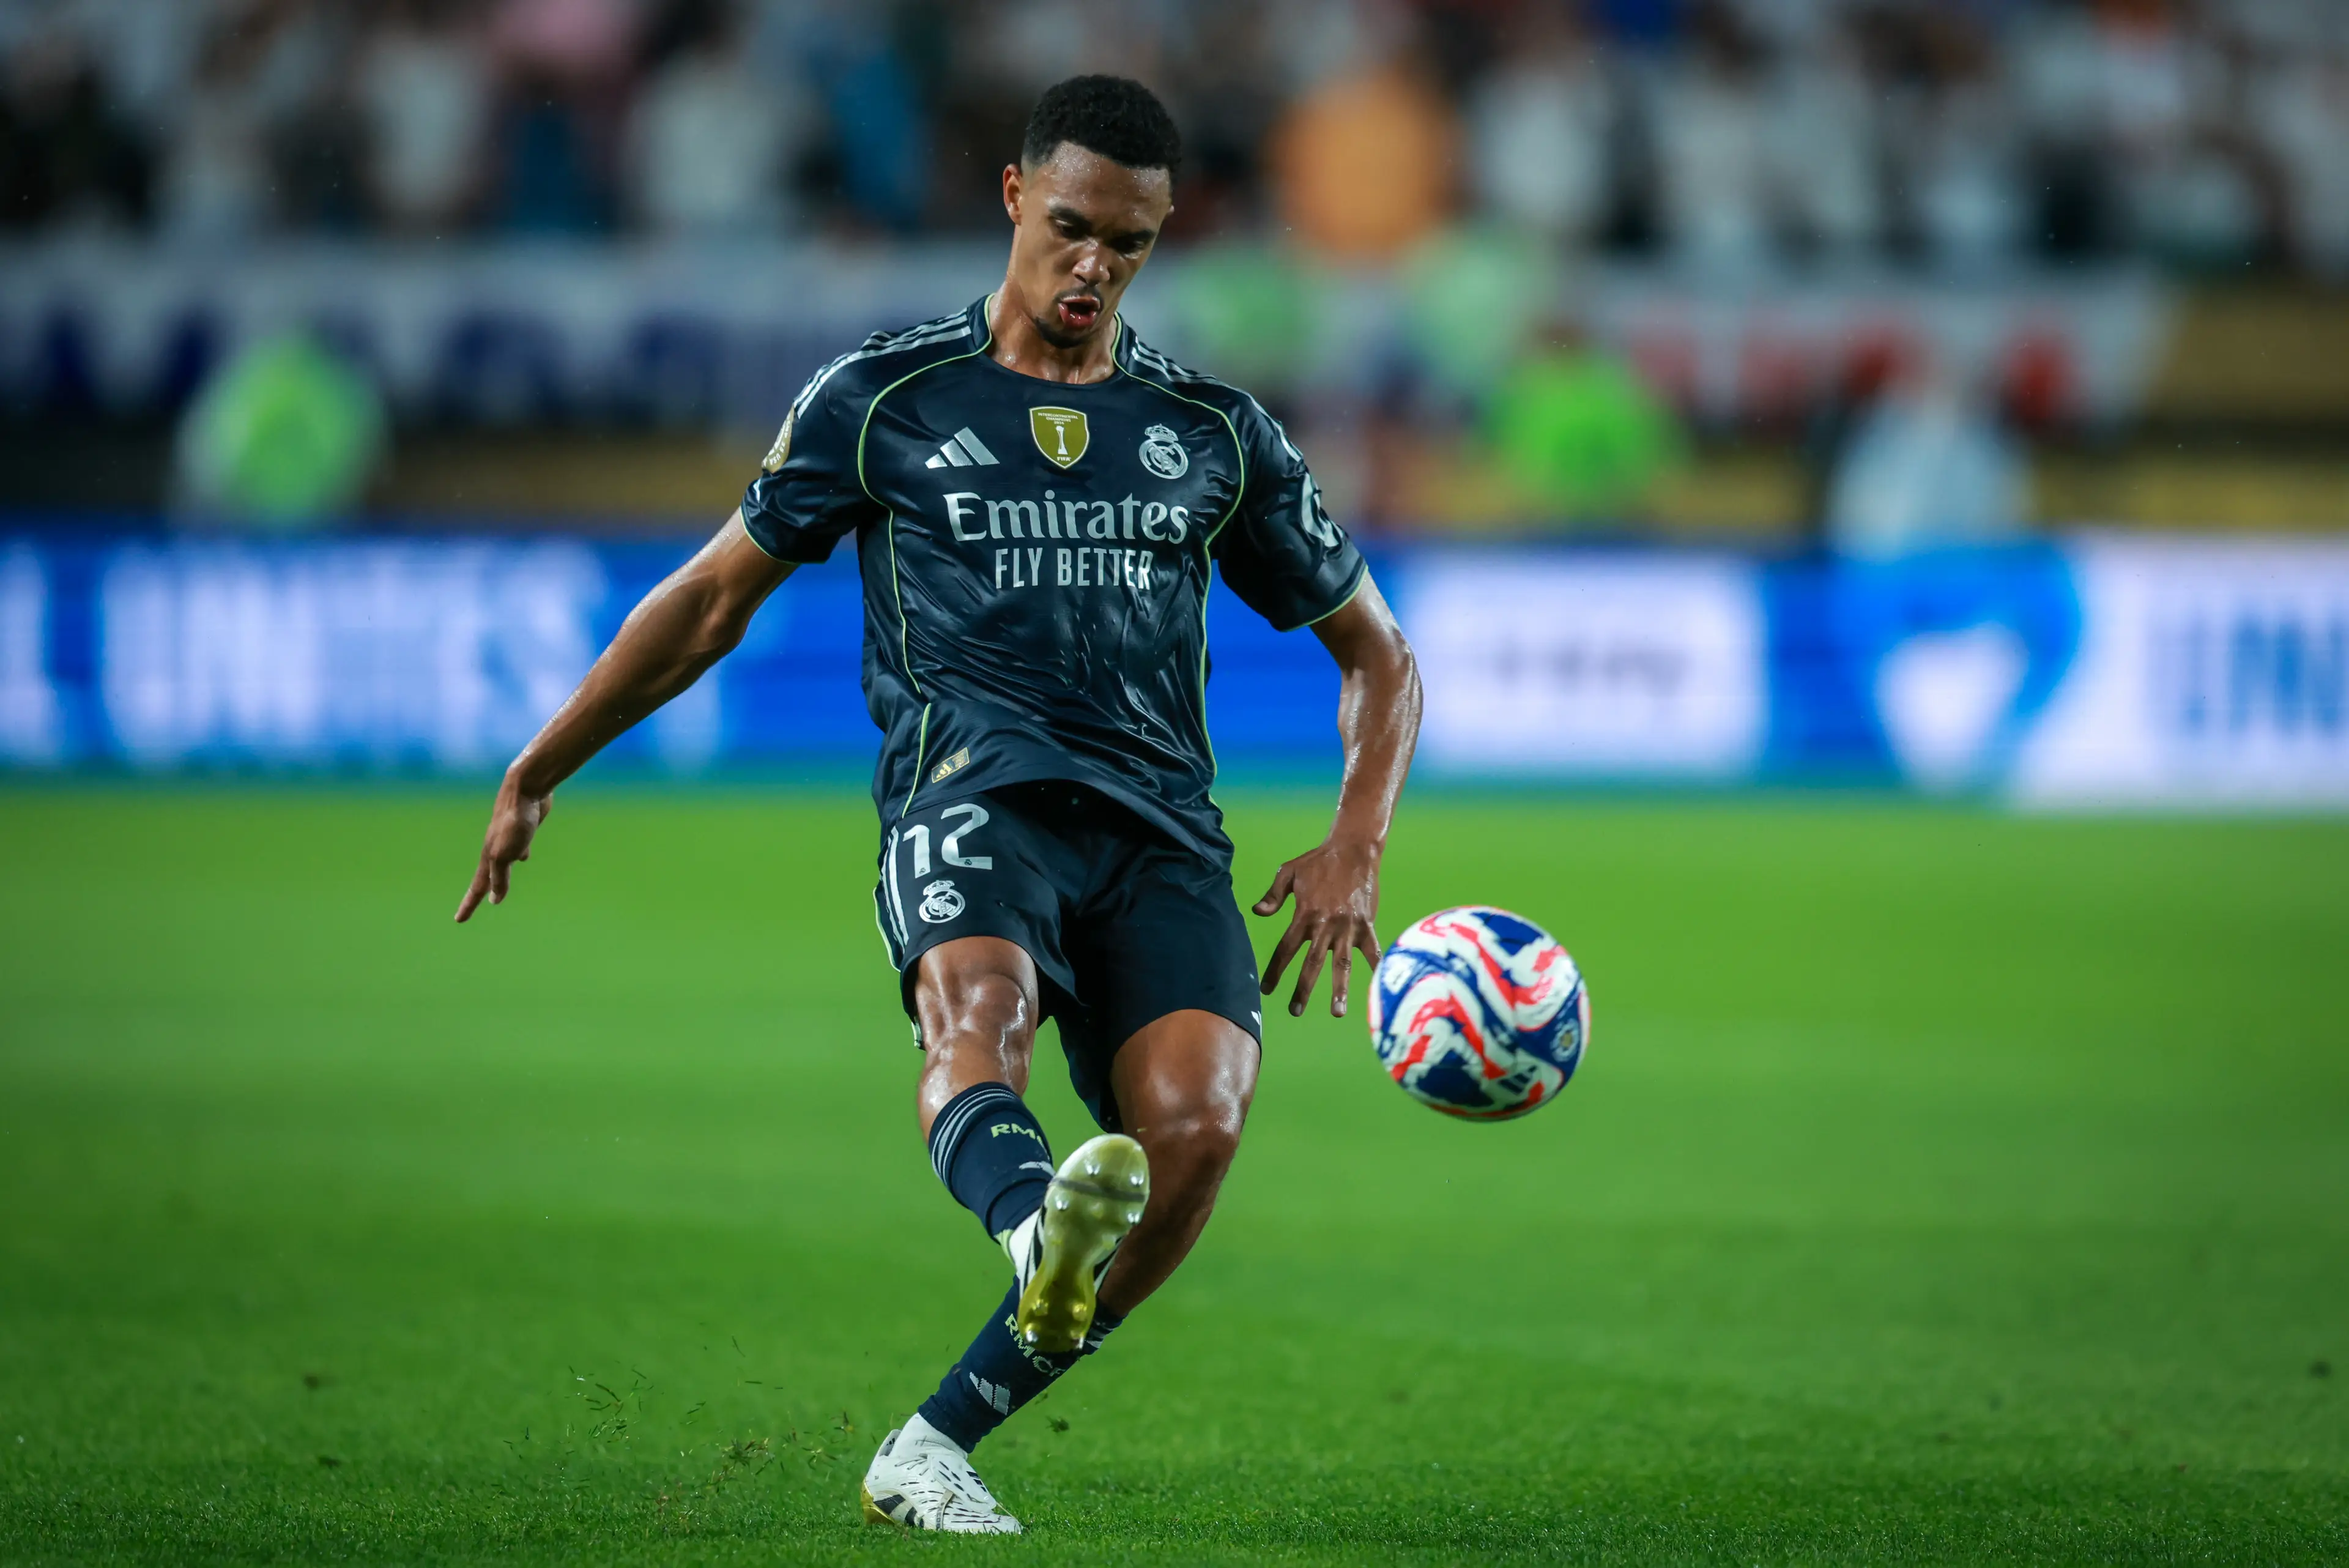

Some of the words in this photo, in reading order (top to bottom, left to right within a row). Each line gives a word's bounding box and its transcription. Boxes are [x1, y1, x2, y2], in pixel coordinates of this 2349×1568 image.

[943, 489, 1189, 544] Emirates
[995, 547, 1042, 589] FLY
[1057, 548, 1153, 590] BETTER
[902, 803, 992, 879] 12
